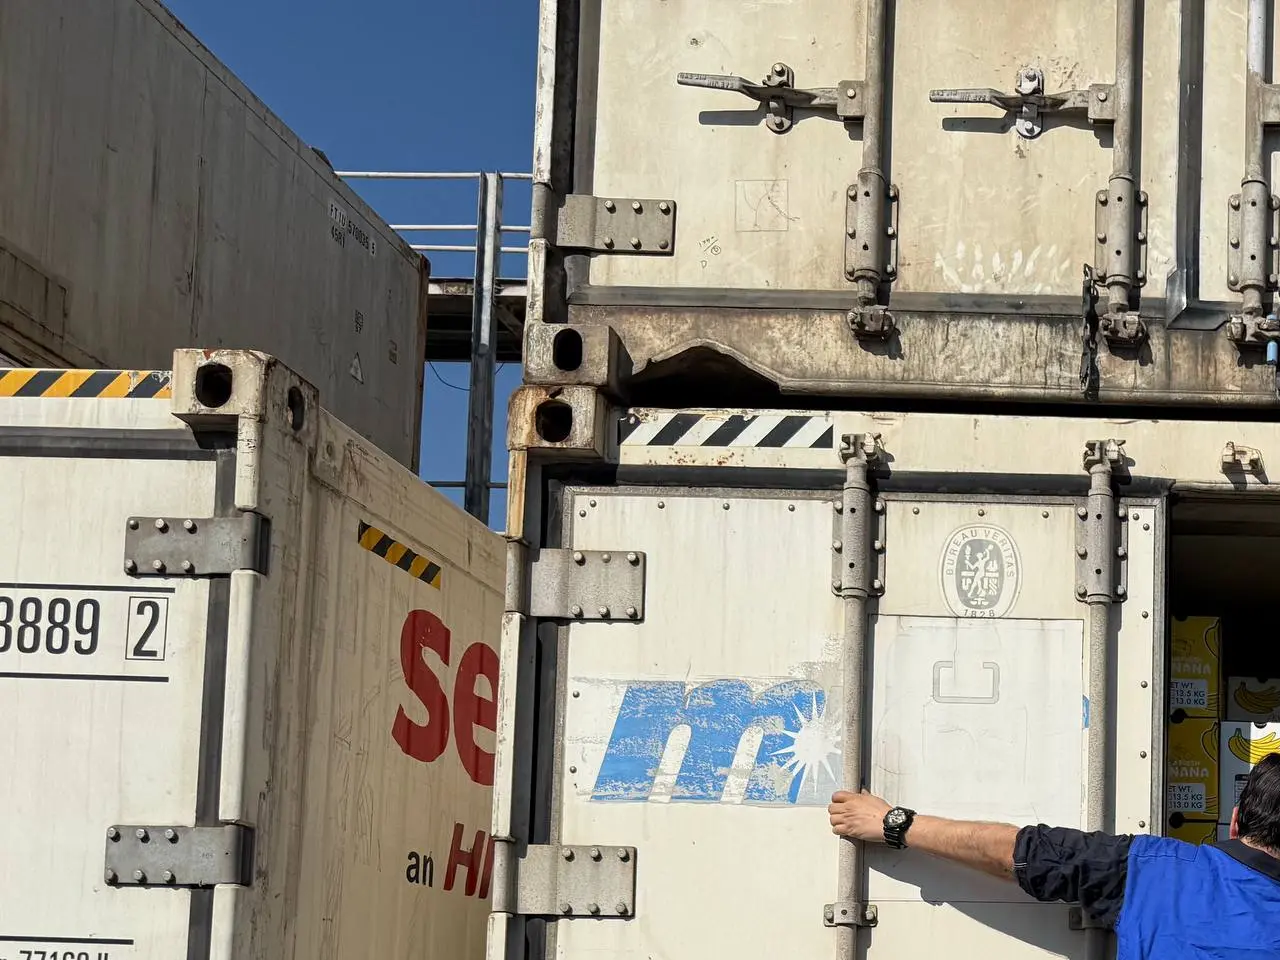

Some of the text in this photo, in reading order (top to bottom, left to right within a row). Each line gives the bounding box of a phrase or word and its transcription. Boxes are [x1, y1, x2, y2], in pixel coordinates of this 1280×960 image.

[946, 529, 1015, 578] BUREAU VERITAS
[133, 600, 160, 657] 2
[406, 851, 433, 888] an
